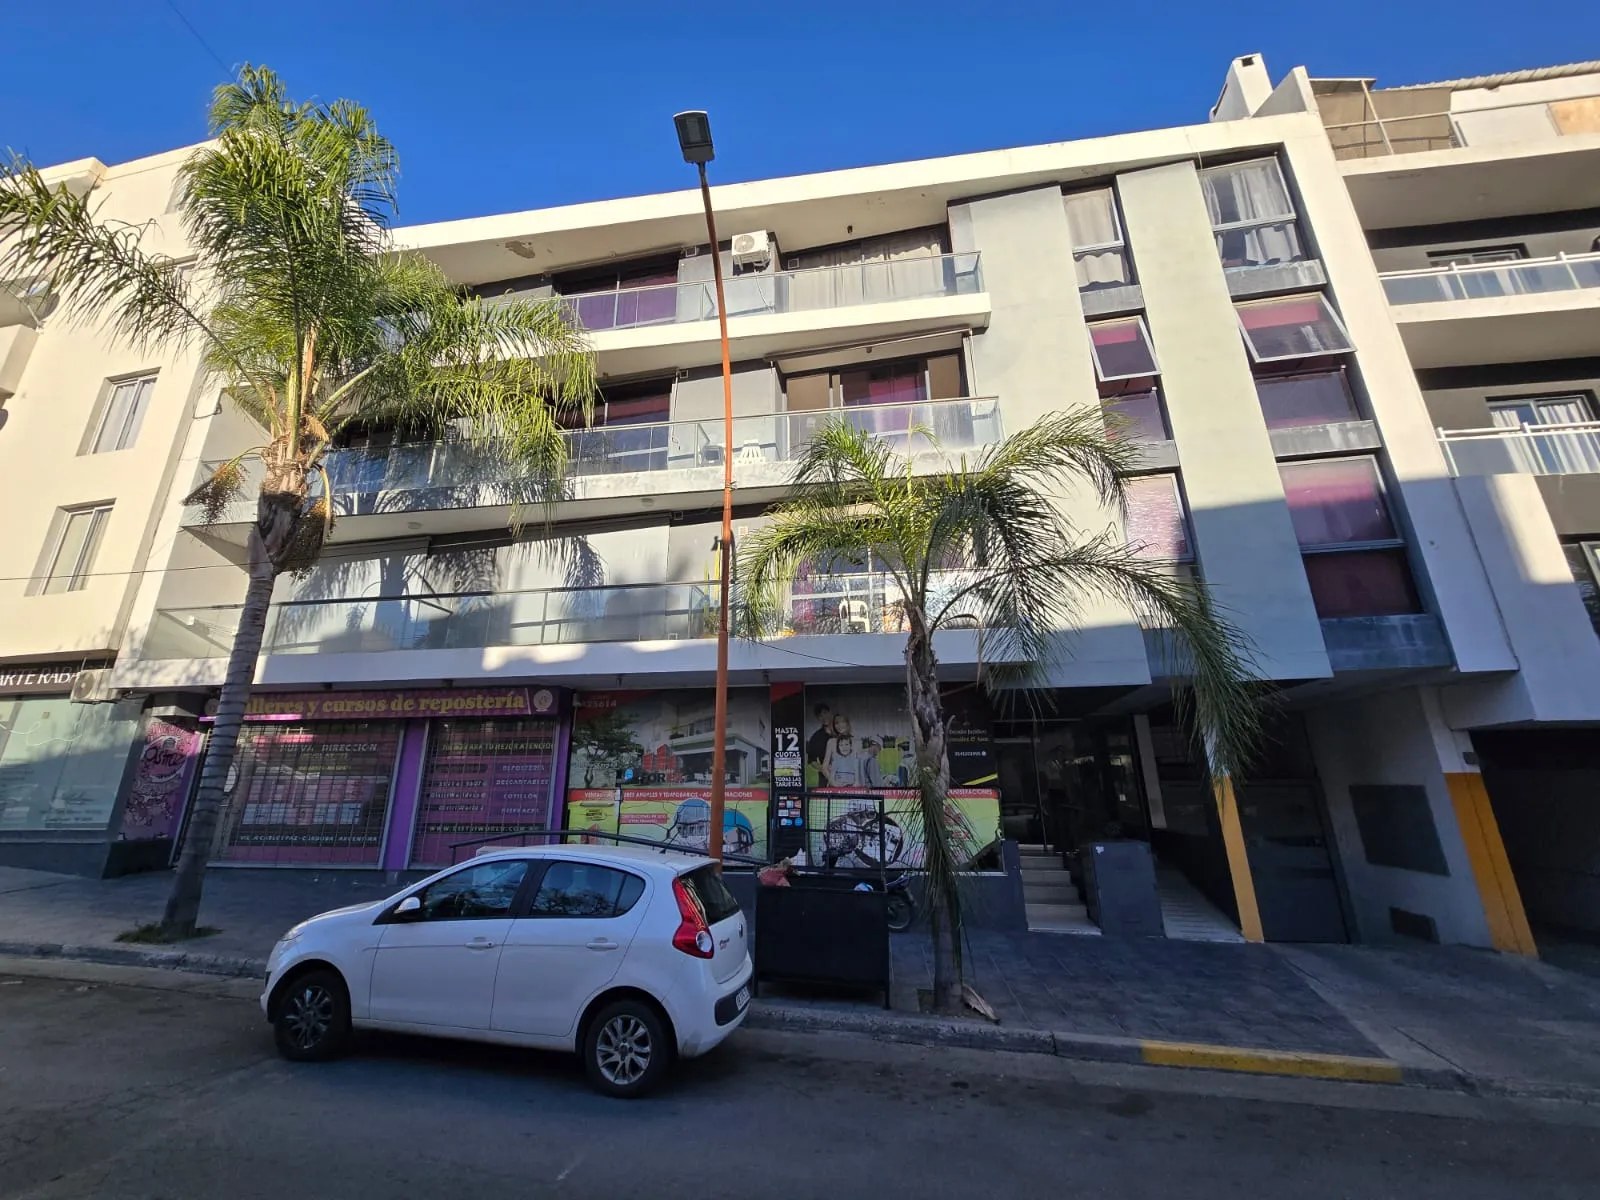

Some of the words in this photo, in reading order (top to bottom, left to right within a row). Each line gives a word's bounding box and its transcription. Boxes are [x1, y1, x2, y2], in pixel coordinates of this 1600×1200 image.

[245, 697, 304, 714] alleres
[306, 701, 318, 716] y
[322, 698, 387, 713] cursos
[390, 694, 414, 711] de
[418, 690, 525, 714] repostería
[775, 734, 800, 751] 12
